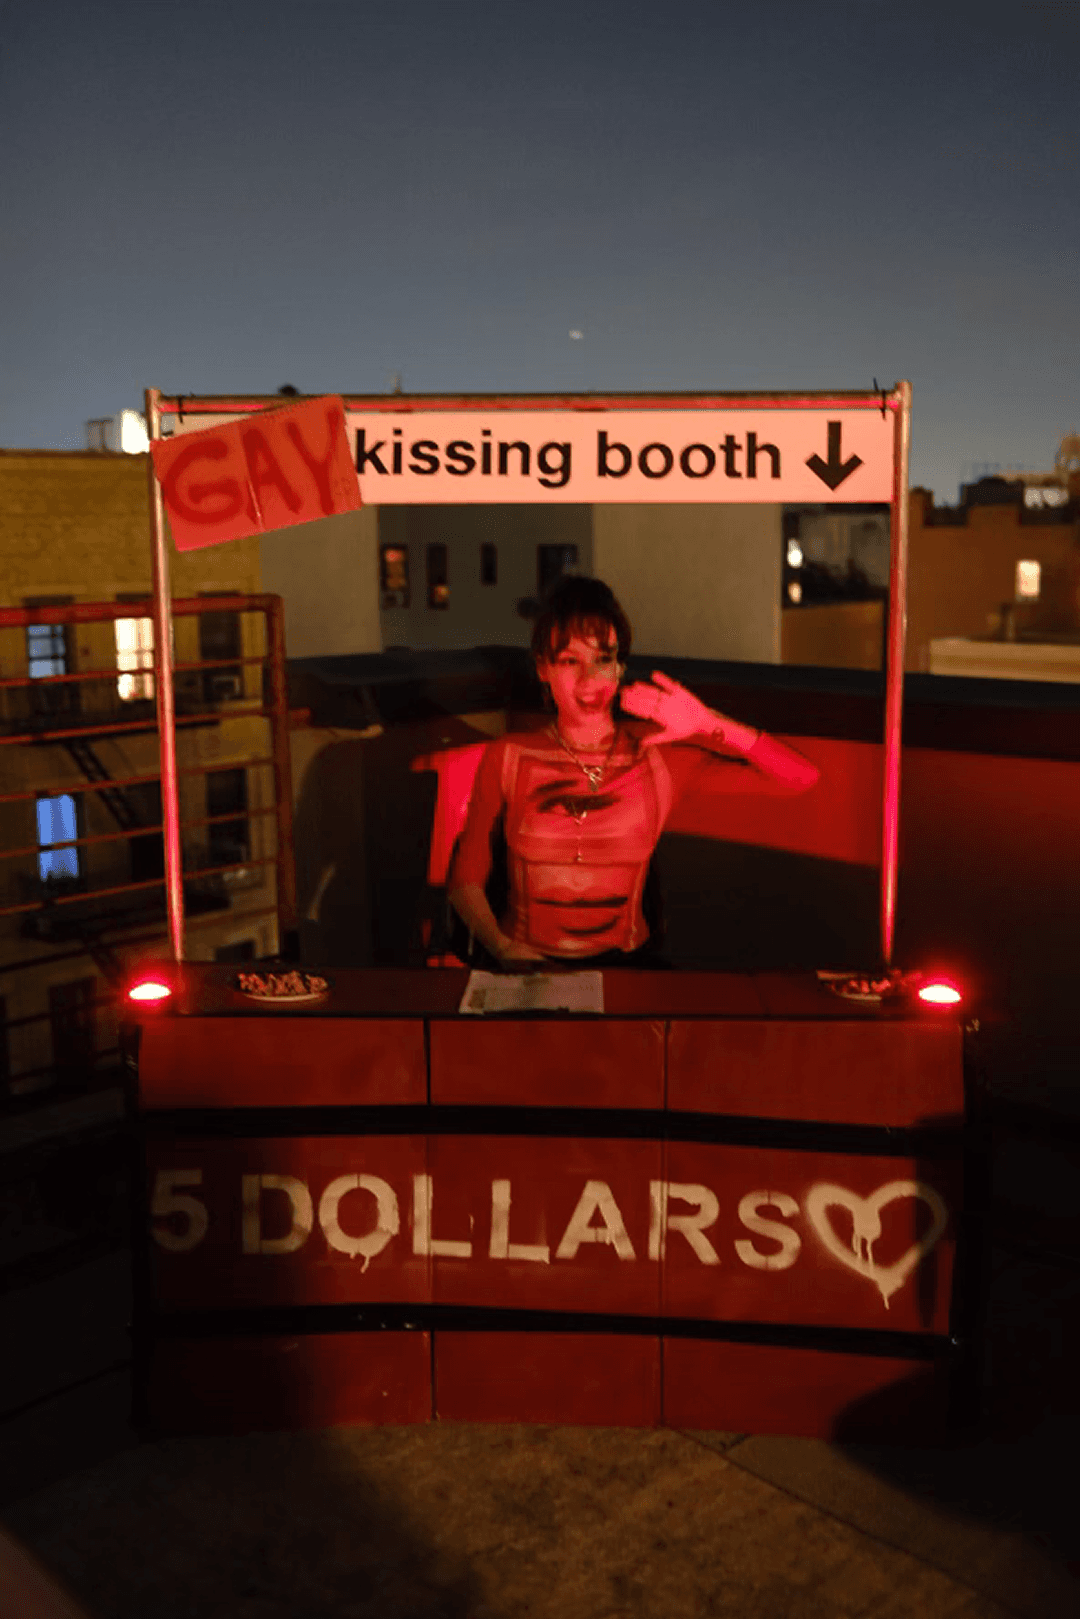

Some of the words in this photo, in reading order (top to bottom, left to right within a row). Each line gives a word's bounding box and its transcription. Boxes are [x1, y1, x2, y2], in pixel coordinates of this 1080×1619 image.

[165, 406, 341, 527] GAY
[356, 429, 573, 488] kissing
[597, 430, 782, 479] booth
[150, 1169, 208, 1253] 5
[241, 1173, 801, 1271] DOLLARS
